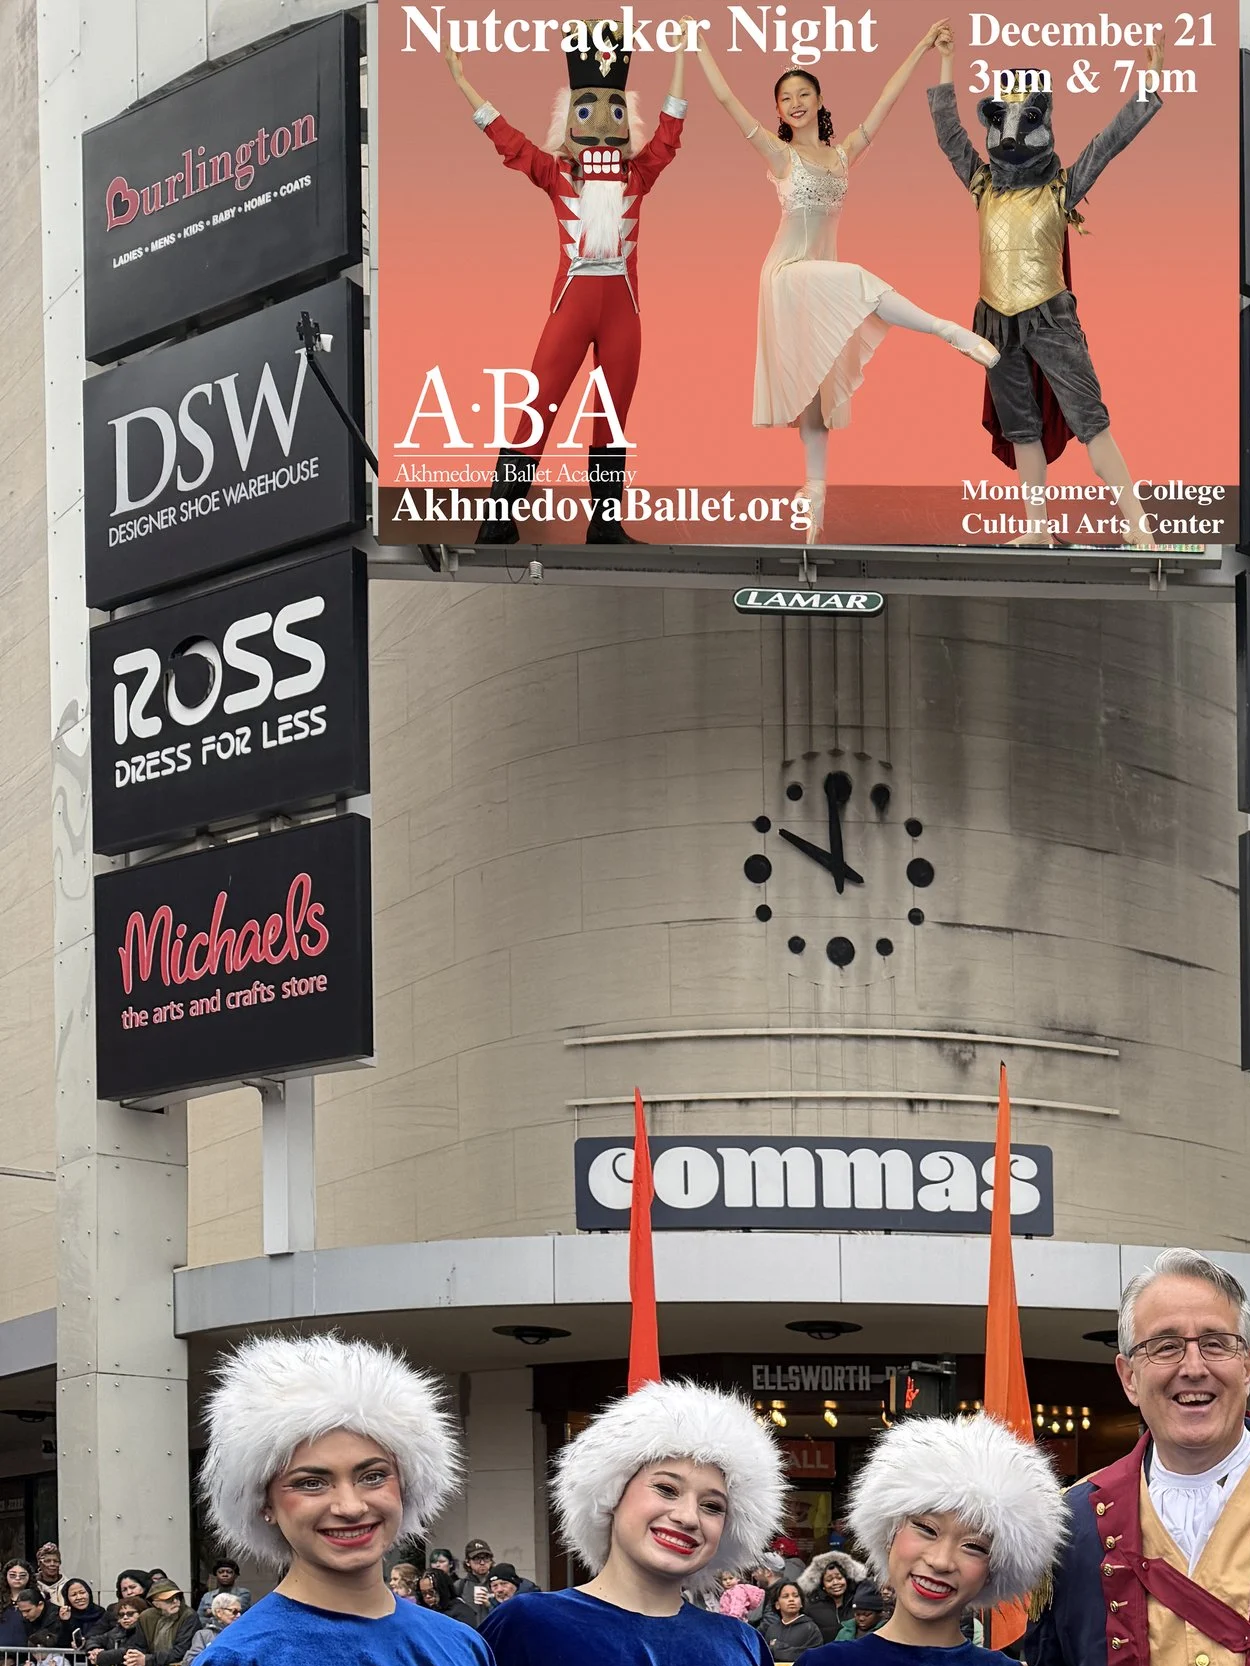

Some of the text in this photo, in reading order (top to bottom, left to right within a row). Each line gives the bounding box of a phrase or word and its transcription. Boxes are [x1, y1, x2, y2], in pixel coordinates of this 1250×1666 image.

[400, 4, 878, 66] Nutcracker Night
[968, 12, 1217, 47] December 21
[968, 59, 1198, 103] 3pm & 7pm
[105, 114, 318, 232] Burlington
[112, 174, 312, 269] LADIES MENS KIDS BABY HOME COATS
[107, 347, 309, 517] DSW
[108, 456, 320, 548] DESIGNER SHOE WAREHOUSE
[393, 463, 637, 489] Akhmedova Ballet Academy
[961, 479, 1226, 506] Montgomery College
[391, 487, 812, 531] AkhmedovaBallet.org
[961, 512, 1225, 535] Cultural Arts Center
[746, 590, 869, 609] LAMAR
[113, 596, 326, 745] ROSS
[115, 704, 327, 788] DRESS FOR LESS
[118, 872, 329, 994] Michaels
[121, 974, 328, 1030] the arts and crafts store
[588, 1146, 1041, 1216] commas
[752, 1364, 871, 1392] ELLSWORTH
